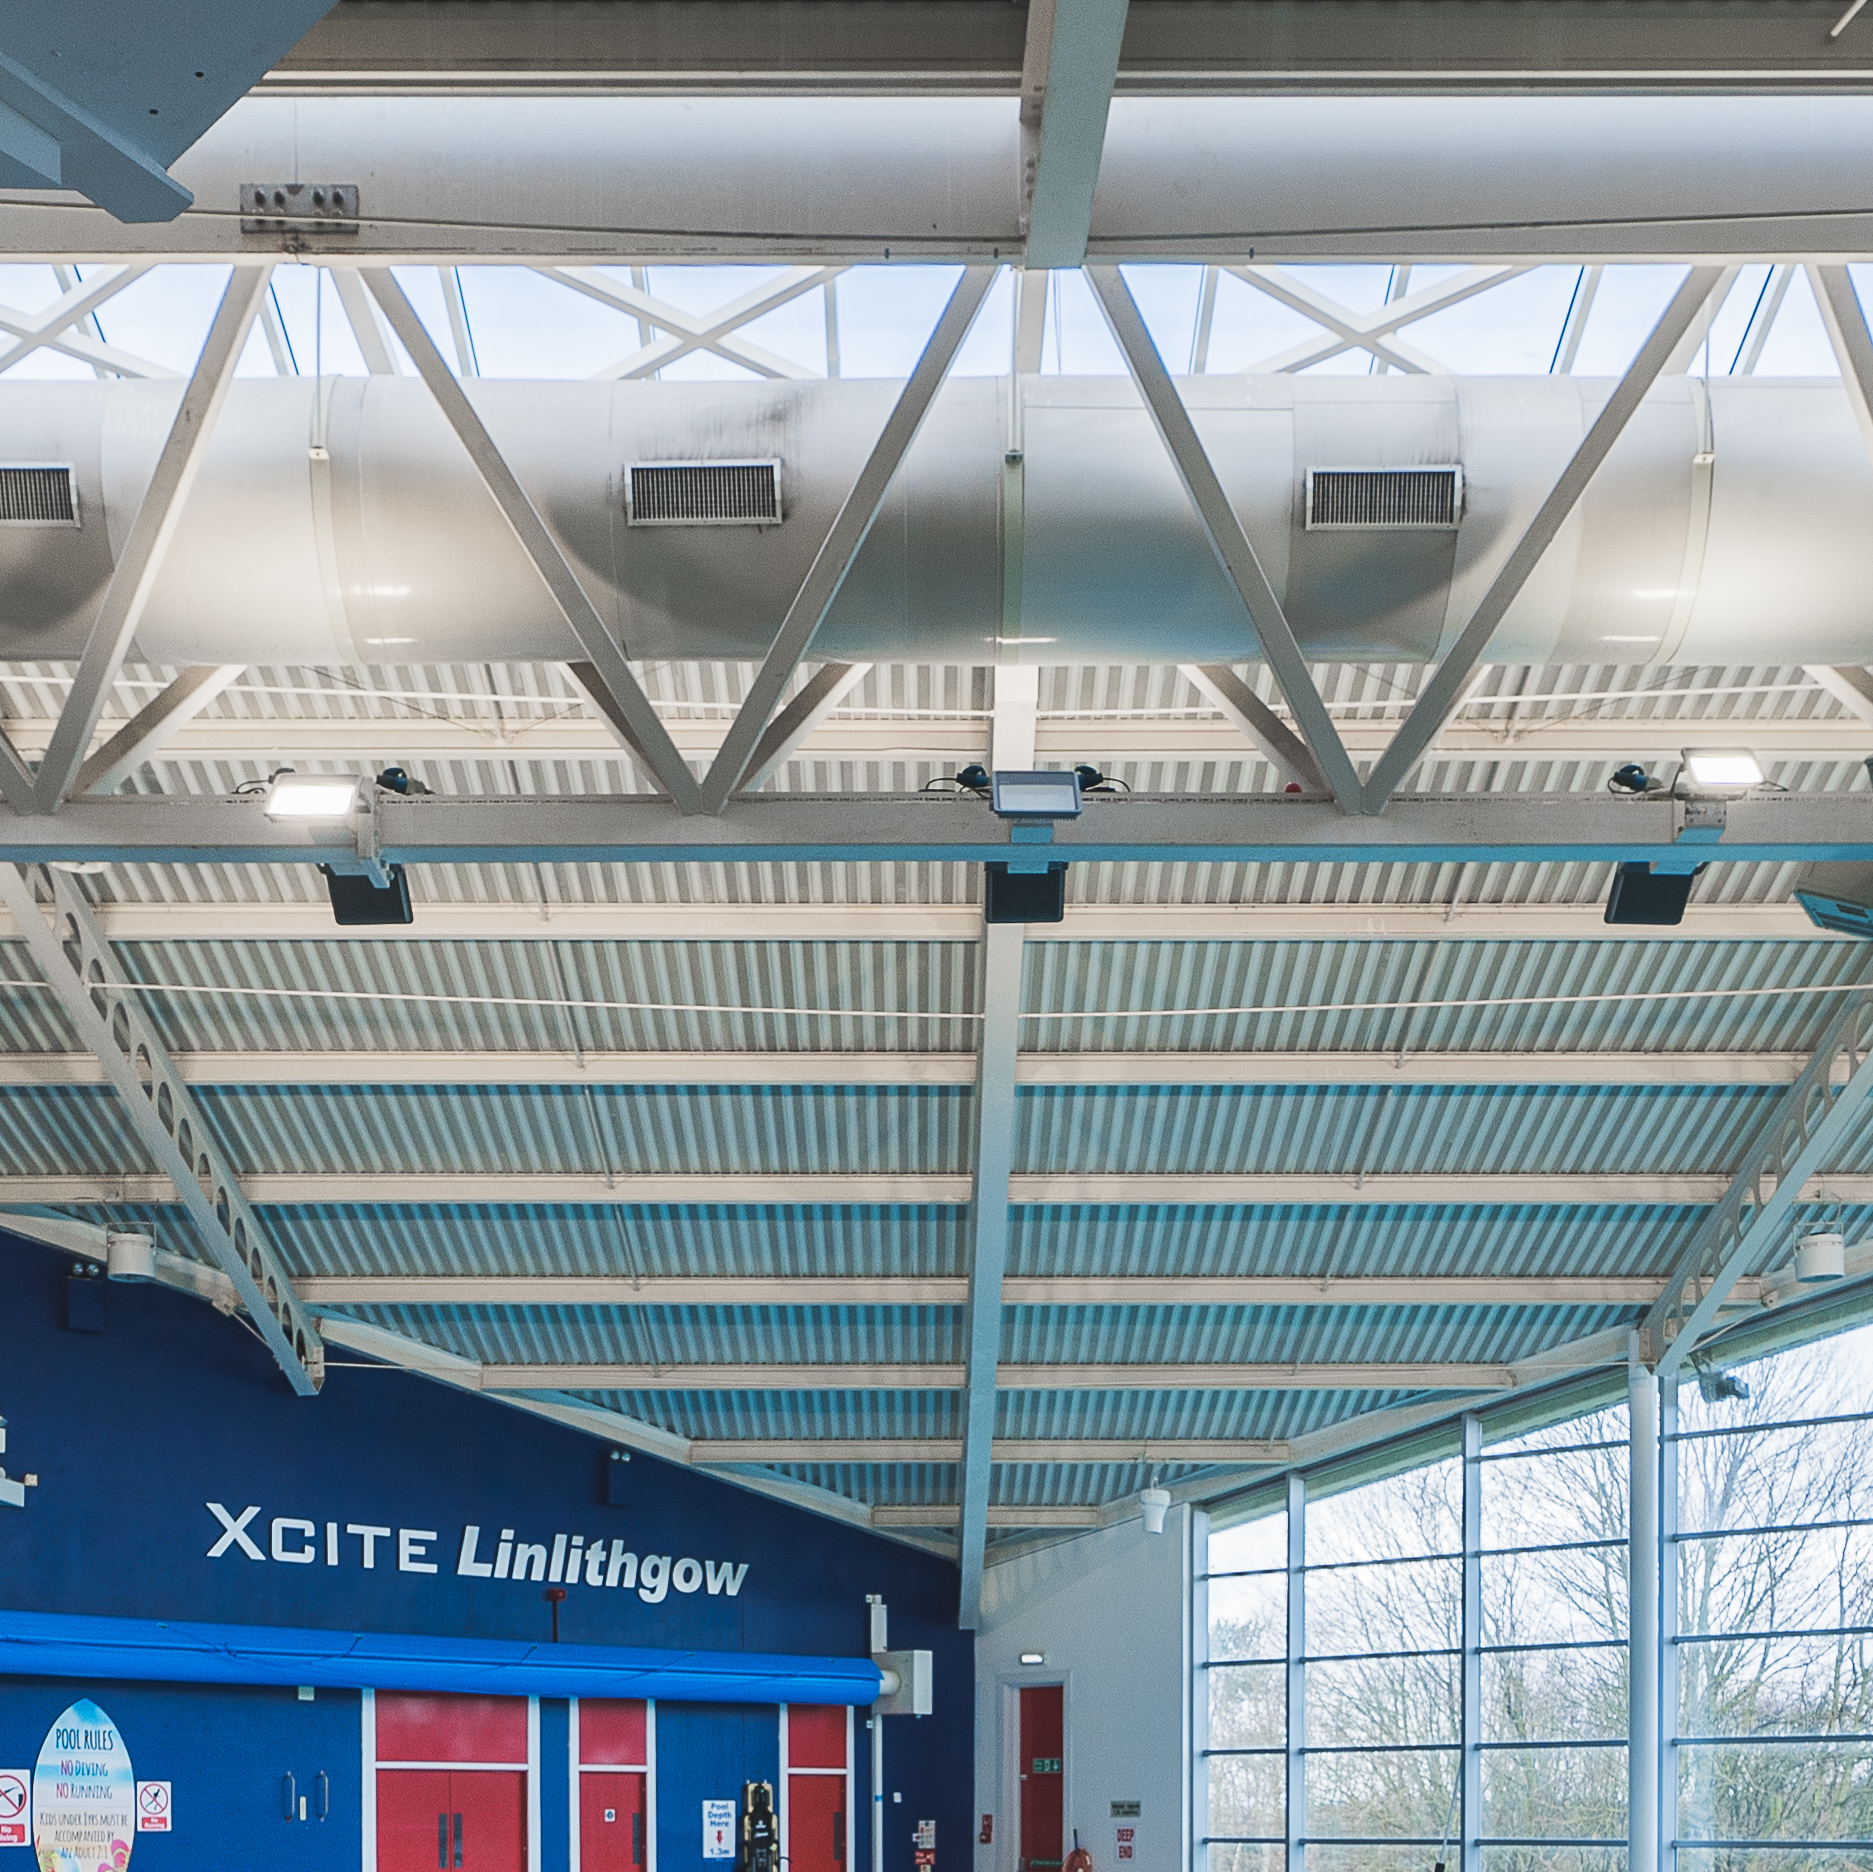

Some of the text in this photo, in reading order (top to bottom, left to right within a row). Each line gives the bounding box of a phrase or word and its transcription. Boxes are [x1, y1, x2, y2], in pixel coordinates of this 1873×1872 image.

[205, 1501, 750, 1604] XCITE Linlithgow
[55, 1728, 114, 1751] POOL RULES
[60, 1760, 108, 1777] NO DIVING
[56, 1782, 113, 1800] NO RUNNING
[39, 1811, 57, 1826] KIDS
[58, 1812, 82, 1826] UNDER
[100, 1813, 120, 1827] MUST
[121, 1813, 128, 1827] BE
[708, 1811, 732, 1819] Depth
[54, 1830, 106, 1843] ACCOMPANIED
[74, 1845, 95, 1859] ADULT
